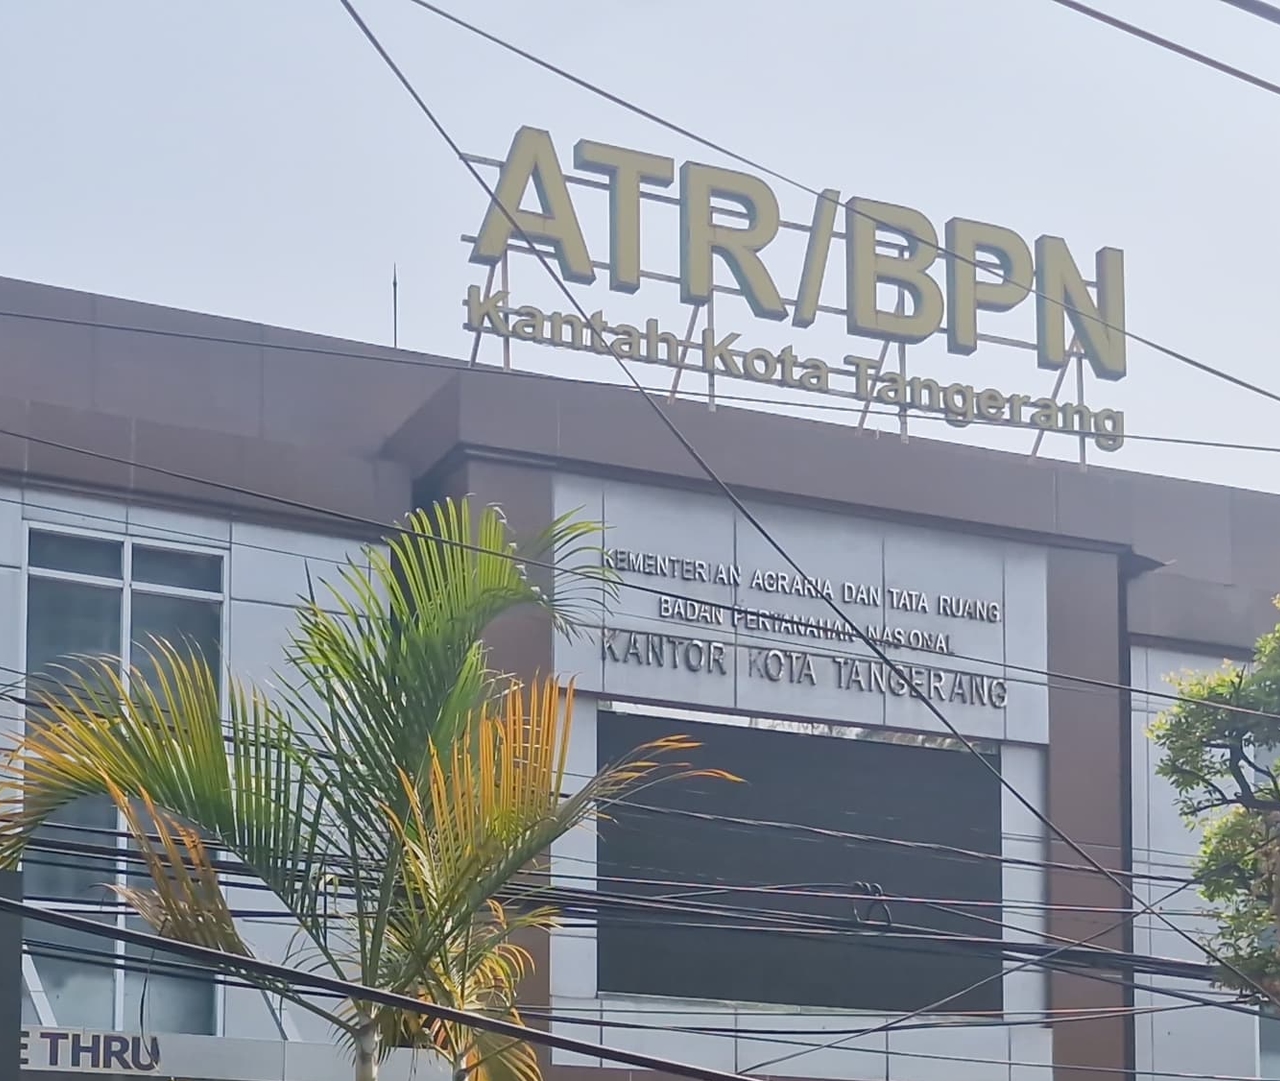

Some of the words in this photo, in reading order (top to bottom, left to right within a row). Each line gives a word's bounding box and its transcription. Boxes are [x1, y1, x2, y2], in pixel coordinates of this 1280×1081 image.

[469, 125, 1126, 380] ATR/BPN
[467, 285, 679, 365] Kantah
[702, 328, 828, 392] Kota
[844, 355, 1125, 452] Tangerang
[603, 549, 741, 586] KEMENTERIAN
[751, 569, 833, 599] AGRARIA
[843, 582, 880, 606] DAN
[888, 588, 929, 613] TATA
[938, 595, 1001, 622] RUANG
[660, 596, 724, 625] BADAN
[732, 605, 857, 642] PERTANAHAN
[867, 624, 955, 655] NASONAL
[603, 628, 726, 675] KANTOR
[749, 650, 817, 685] KOTA
[833, 656, 1008, 708] TANGERANG
[40, 1032, 160, 1070] THRU
